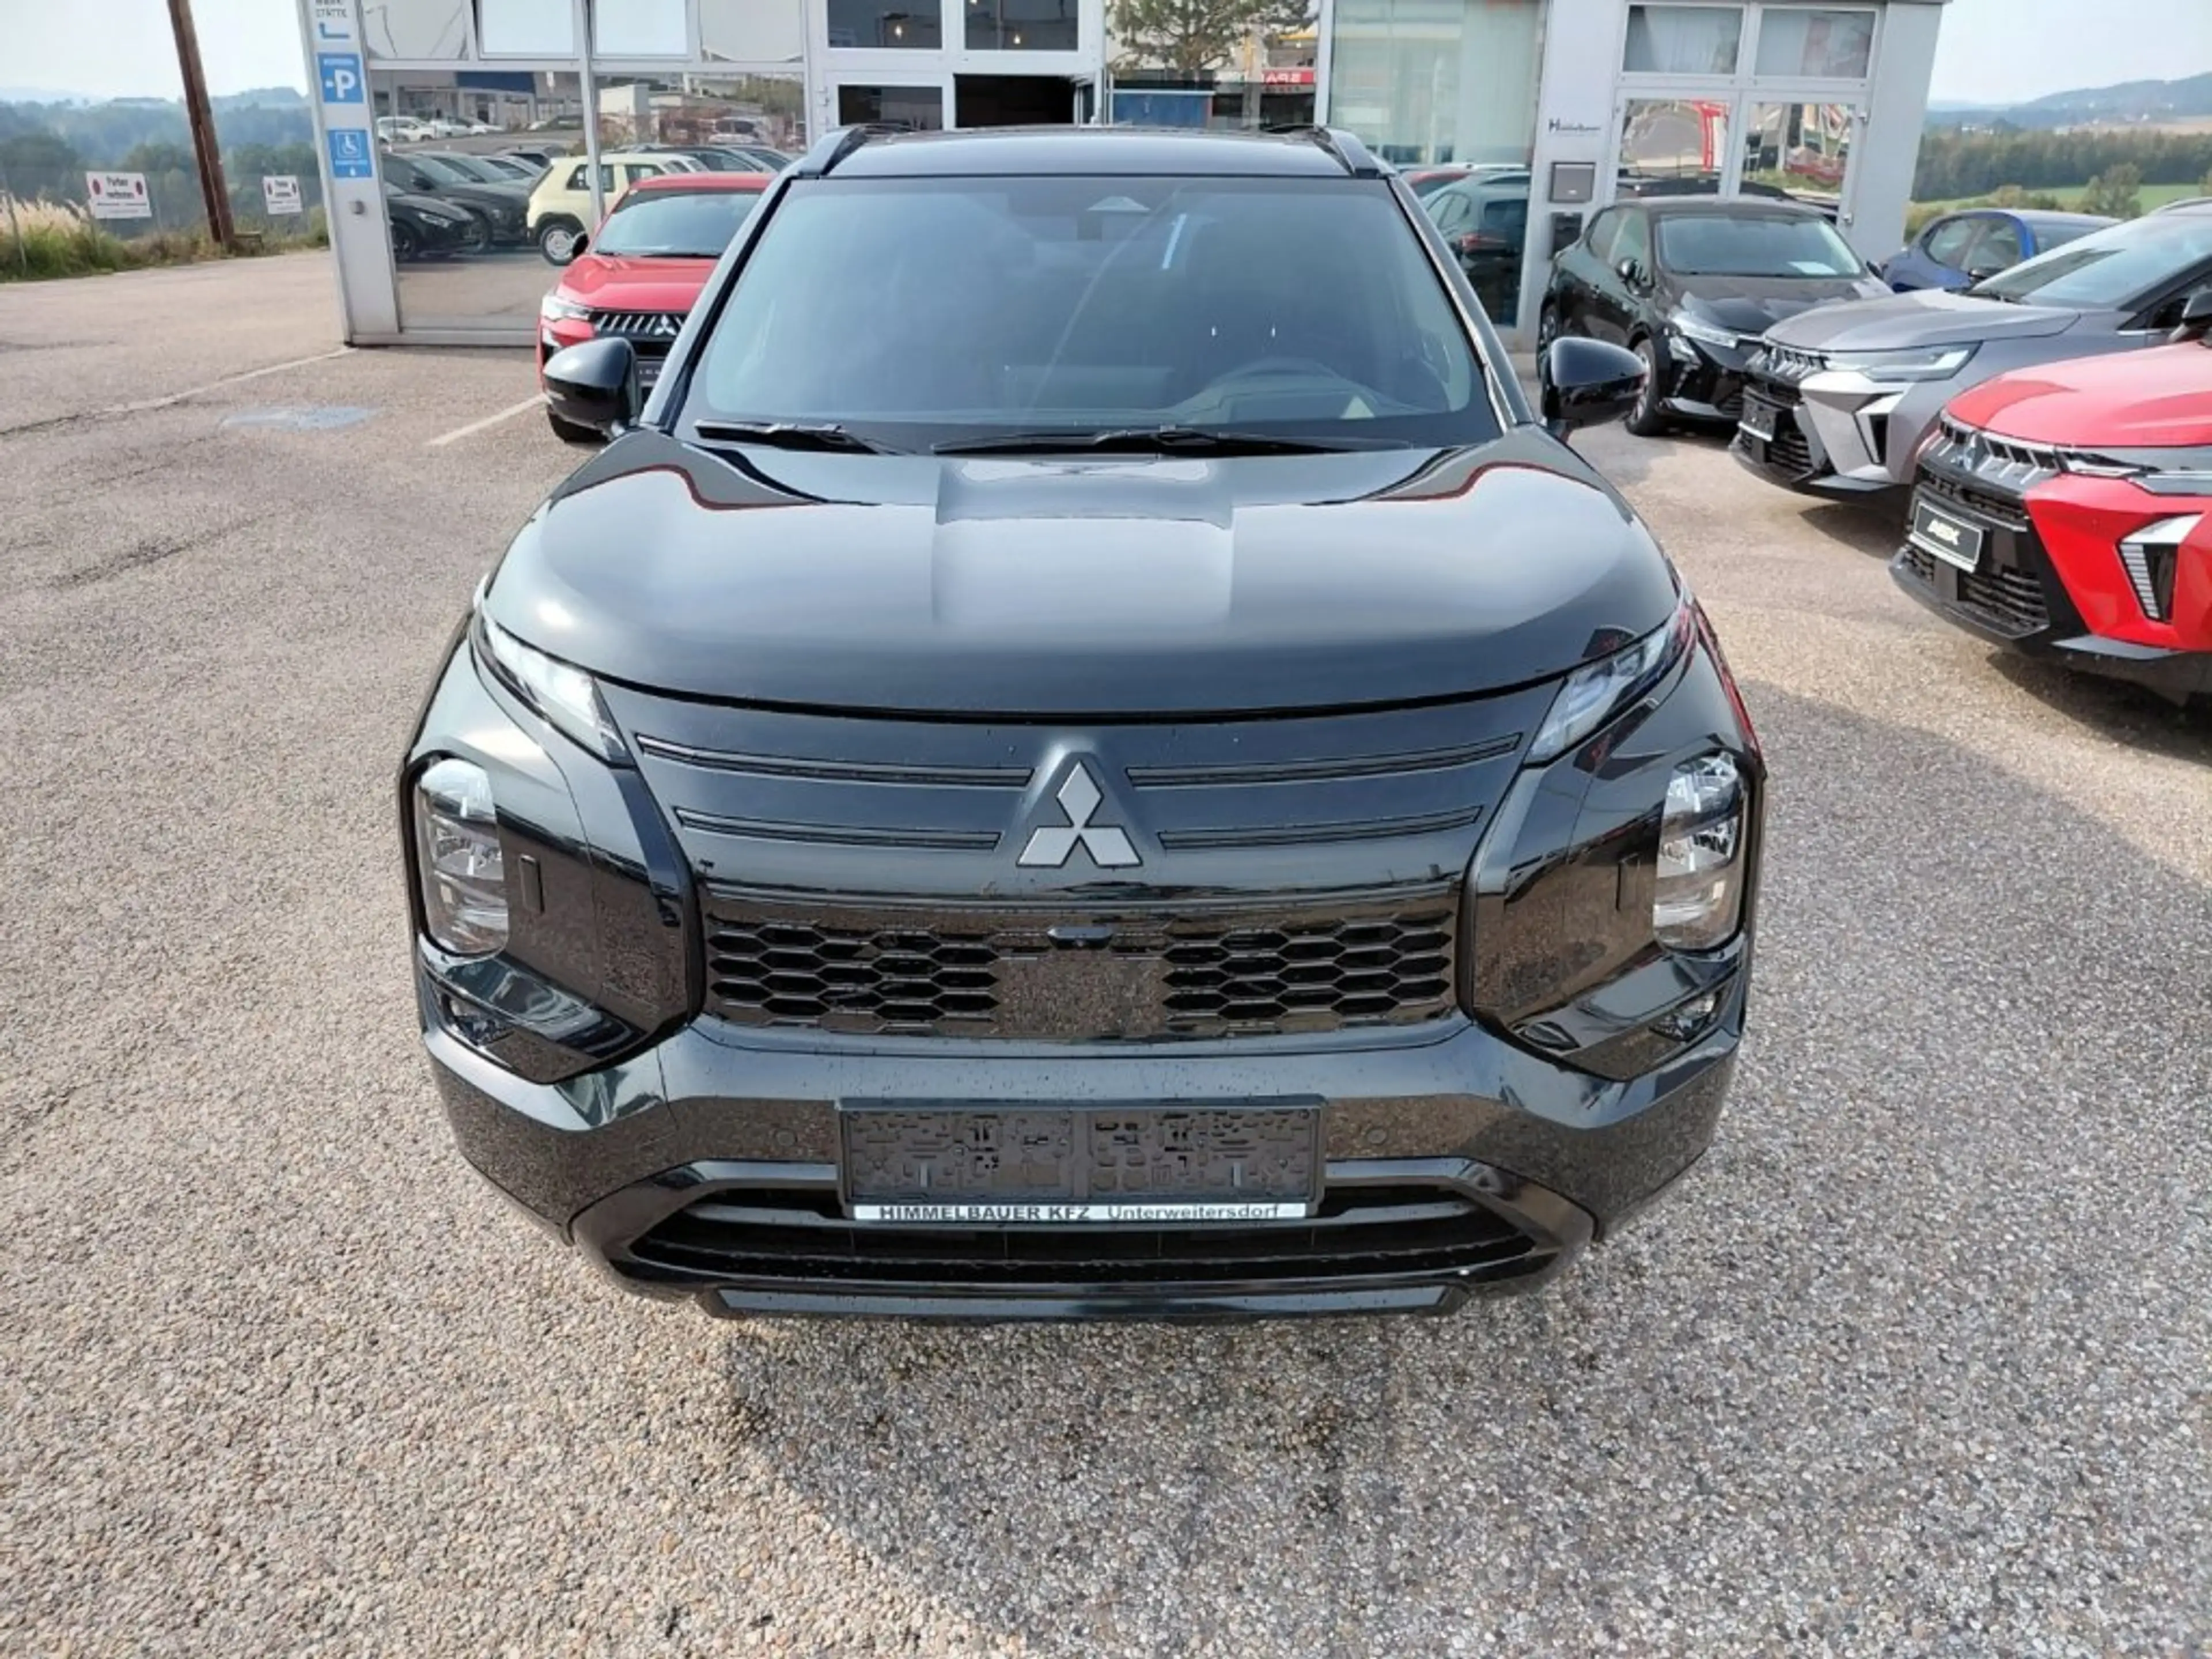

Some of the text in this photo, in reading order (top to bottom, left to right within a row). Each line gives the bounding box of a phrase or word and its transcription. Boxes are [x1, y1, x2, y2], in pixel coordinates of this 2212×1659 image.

[881, 1204, 1277, 1220] HIMMELBAUER KFZ Unterweitersdorf
